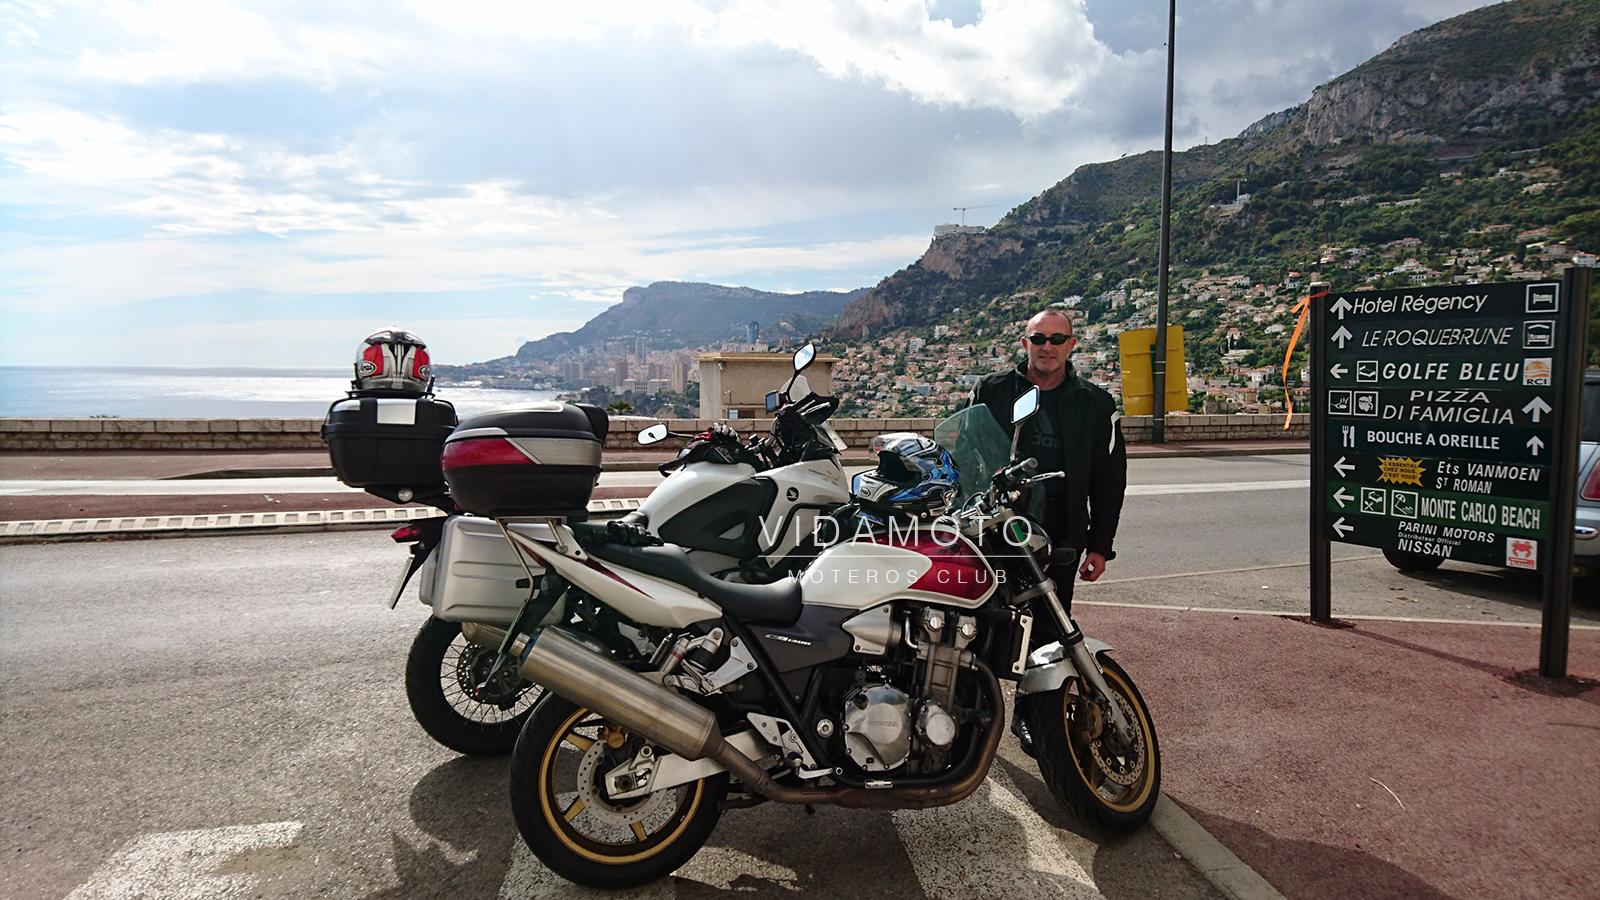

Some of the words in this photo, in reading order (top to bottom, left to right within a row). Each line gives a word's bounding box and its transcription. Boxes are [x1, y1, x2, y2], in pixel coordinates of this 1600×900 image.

[1353, 296, 1397, 314] Hotel
[1401, 294, 1488, 313] Régency
[1362, 330, 1382, 347] LE
[1383, 327, 1513, 347] ROQUEBRUNE
[1382, 362, 1449, 381] GOLFE
[1459, 362, 1520, 381] BLEU
[1410, 390, 1490, 403] PIZZA
[1383, 405, 1402, 420] DI
[1410, 405, 1514, 425] FAMIGLIA
[1367, 430, 1423, 445] BOUCHE
[1425, 434, 1436, 445] A
[1439, 434, 1500, 450] OREILLE
[1437, 461, 1459, 474] Ets
[1467, 463, 1540, 481] VANMOEN
[1453, 479, 1492, 494] ROMAN
[1421, 497, 1456, 520] MONTE
[1461, 501, 1497, 524] CARLO
[1502, 505, 1540, 530] BEACH
[1398, 521, 1438, 535] PARINI
[1442, 527, 1495, 543] MOTORS
[1398, 538, 1452, 557] NISSAN
